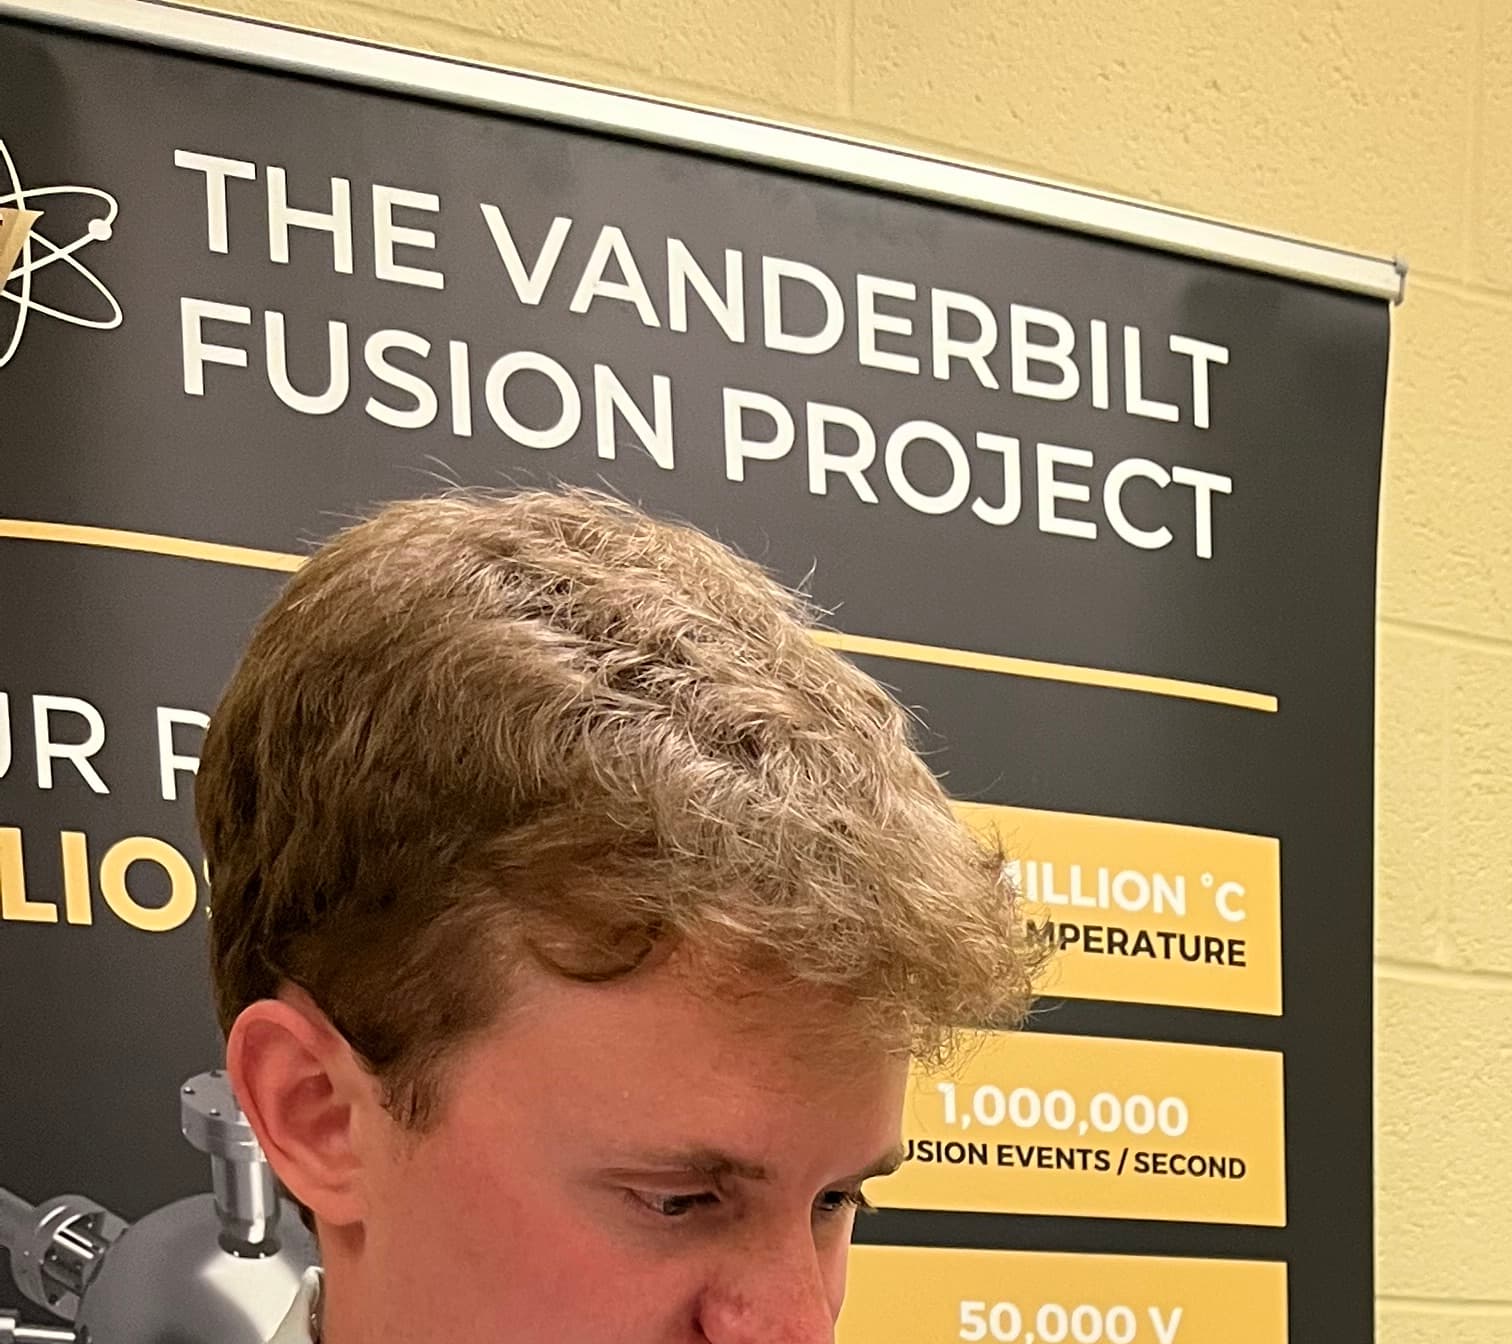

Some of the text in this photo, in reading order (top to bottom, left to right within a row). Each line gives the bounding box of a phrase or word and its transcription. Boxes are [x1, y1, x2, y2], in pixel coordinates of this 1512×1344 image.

[174, 149, 1230, 429] THE VANDERBILT
[180, 296, 1232, 558] FUSION PROJECT
[0, 826, 212, 932] LIO
[1026, 919, 1247, 968] MPERATURE
[936, 1082, 1189, 1137] 1,000,000
[996, 1144, 1111, 1172] EVENTS
[1116, 1147, 1129, 1176] /
[1133, 1152, 1247, 1180] SECOND
